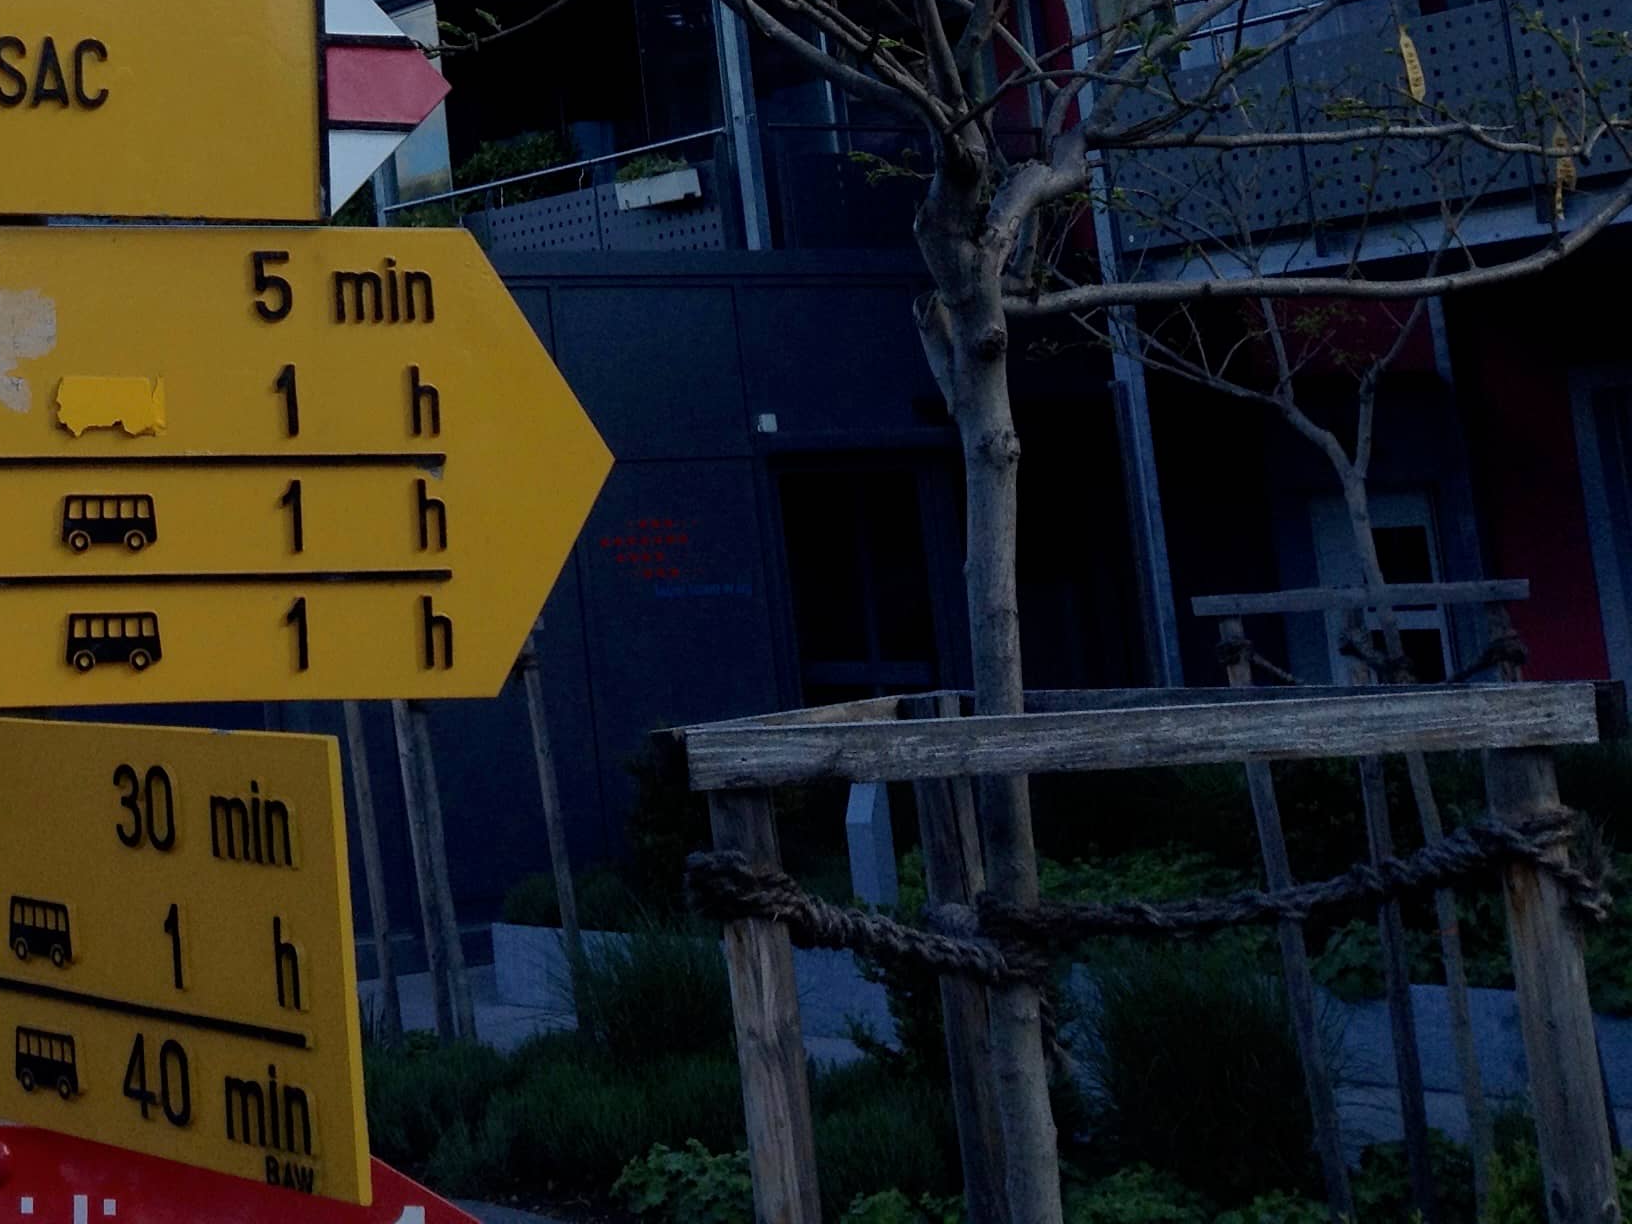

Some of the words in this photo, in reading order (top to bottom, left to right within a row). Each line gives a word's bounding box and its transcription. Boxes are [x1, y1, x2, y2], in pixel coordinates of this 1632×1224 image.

[251, 250, 294, 323] 5
[333, 257, 436, 324] min
[275, 363, 299, 437] 1
[409, 364, 441, 437] h
[280, 479, 304, 552] 1
[416, 478, 448, 551] h
[286, 597, 309, 671] 1
[420, 595, 454, 670] h
[112, 764, 176, 853] 30
[209, 780, 294, 867] min
[164, 903, 185, 990] 1
[272, 915, 303, 1011] h
[122, 1032, 192, 1128] 40
[224, 1064, 314, 1156] min
[265, 1154, 315, 1195] BAW
